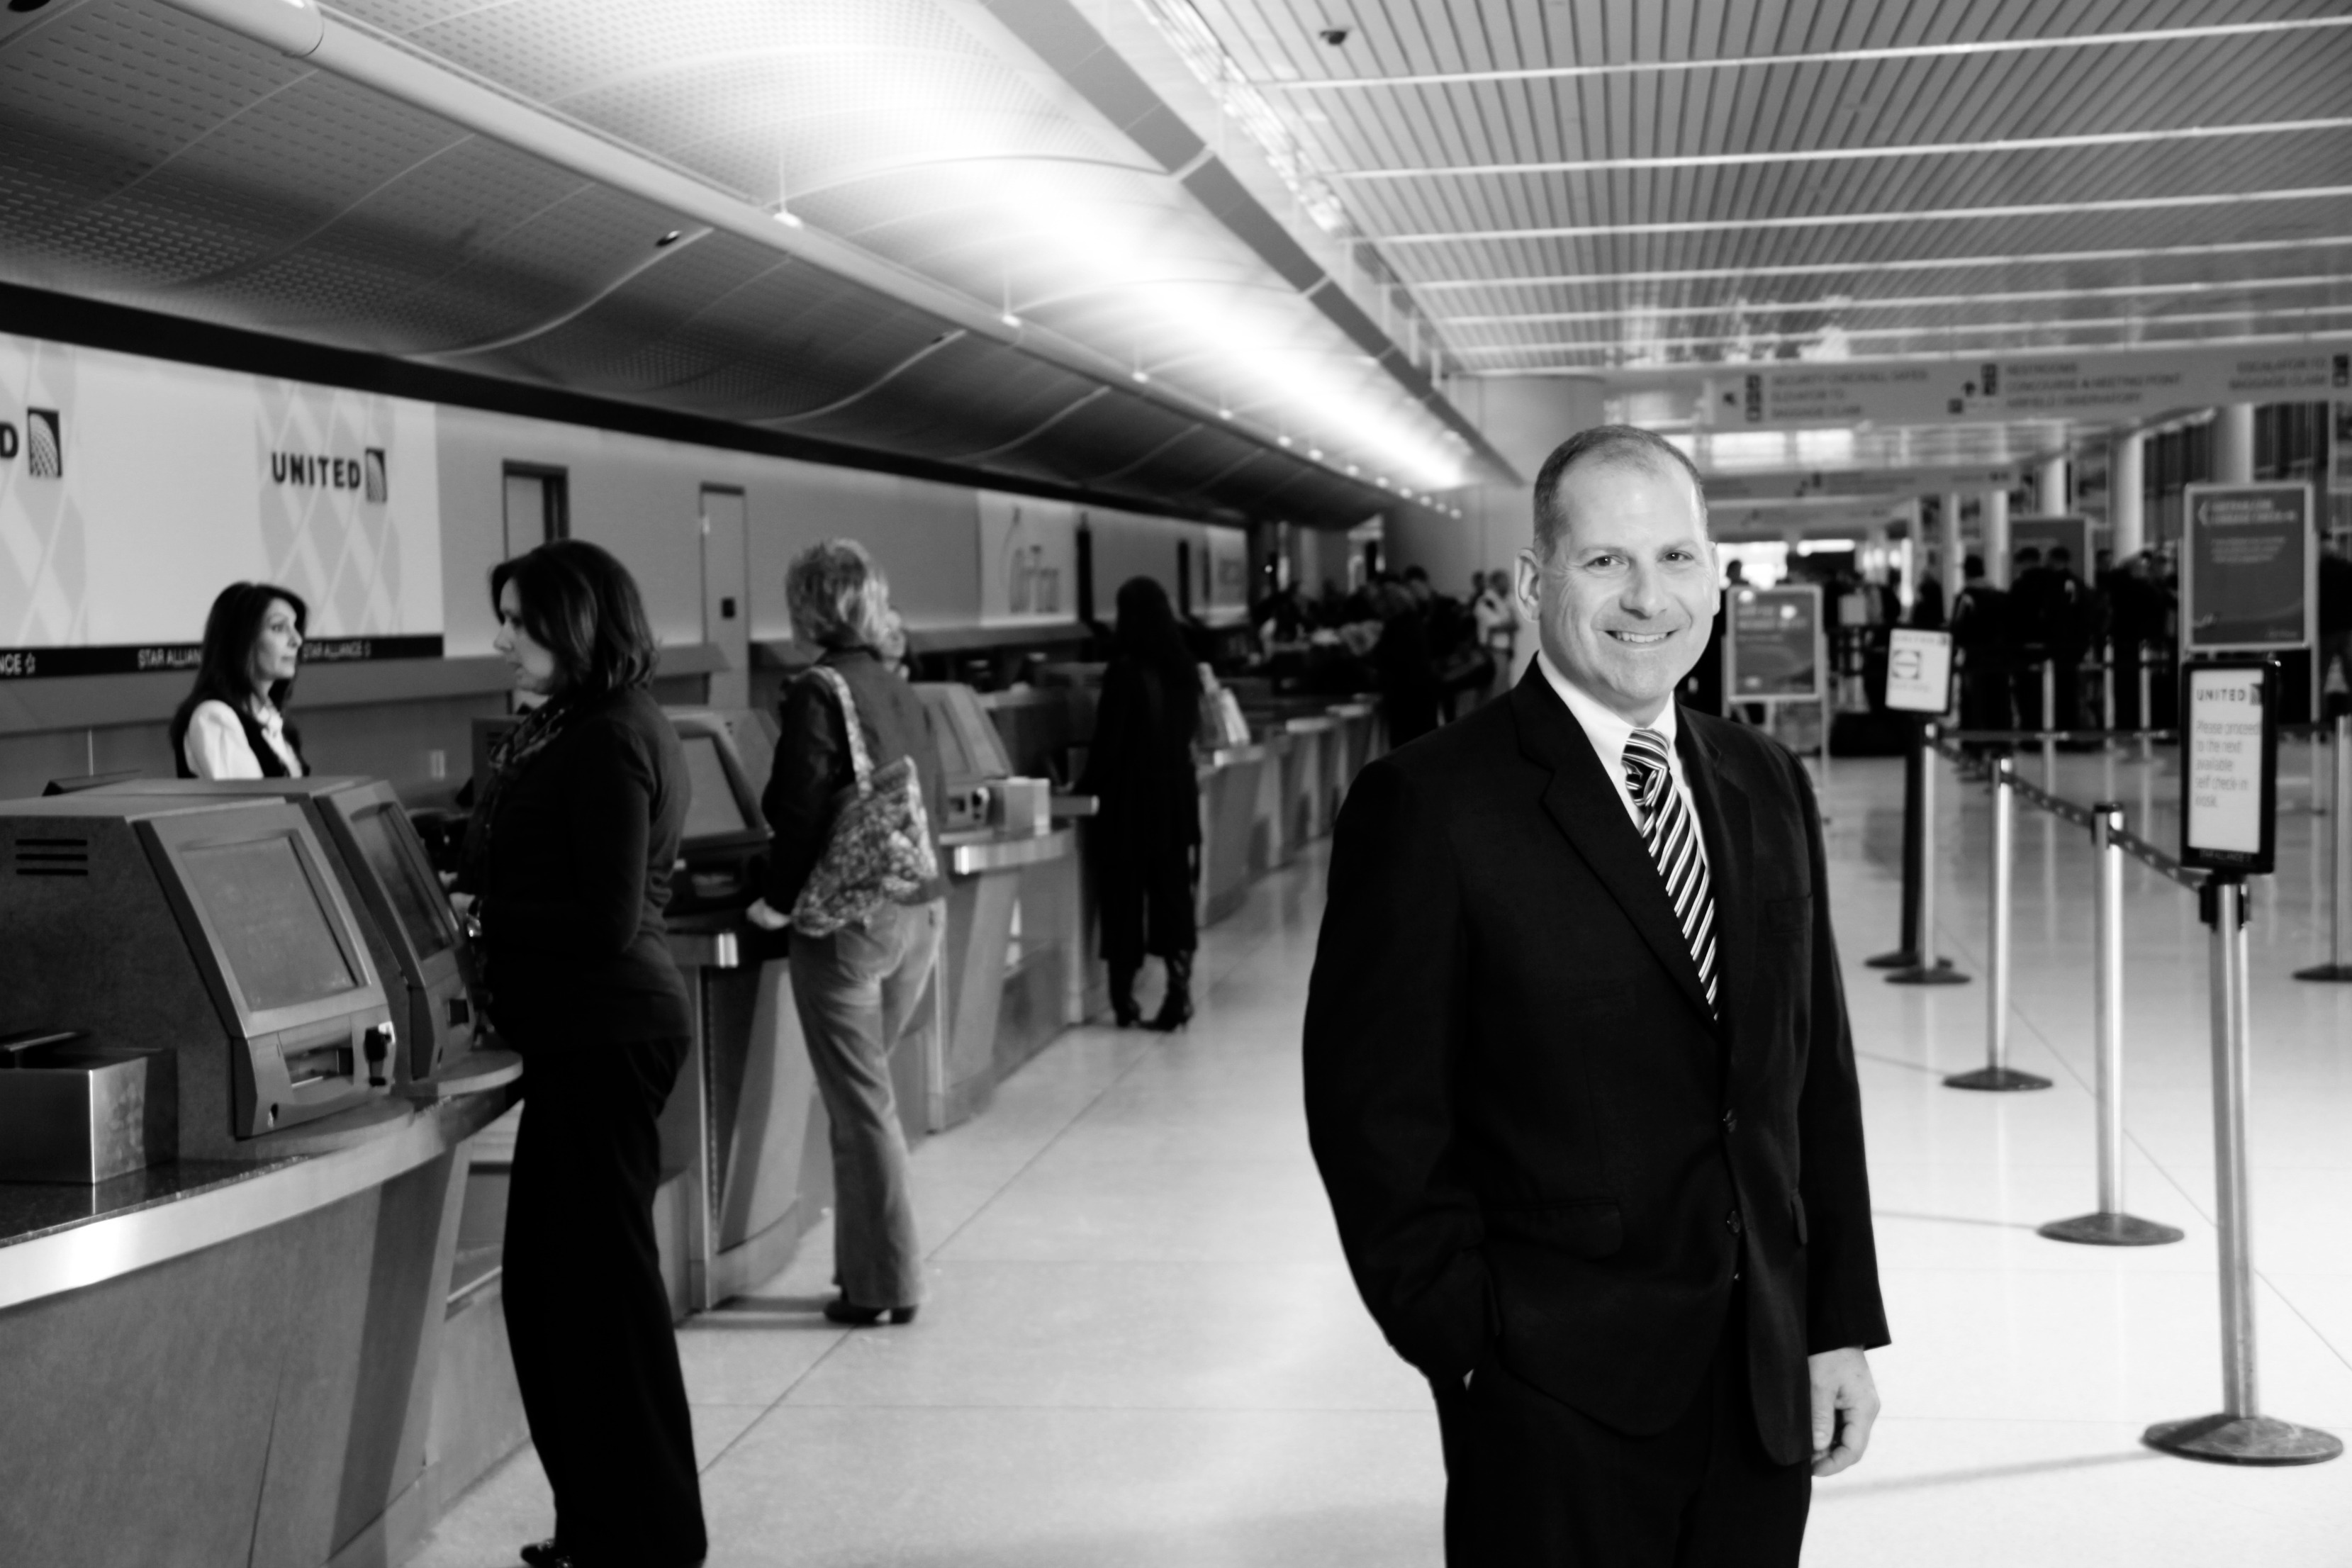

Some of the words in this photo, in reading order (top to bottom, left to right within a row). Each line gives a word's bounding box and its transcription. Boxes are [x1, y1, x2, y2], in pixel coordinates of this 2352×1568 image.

[271, 451, 361, 489] UNITED
[138, 647, 164, 669] STAR
[2196, 688, 2246, 702] UNITED
[2196, 720, 2223, 734] Please
[2224, 722, 2260, 737] proceed
[2222, 741, 2242, 754] next
